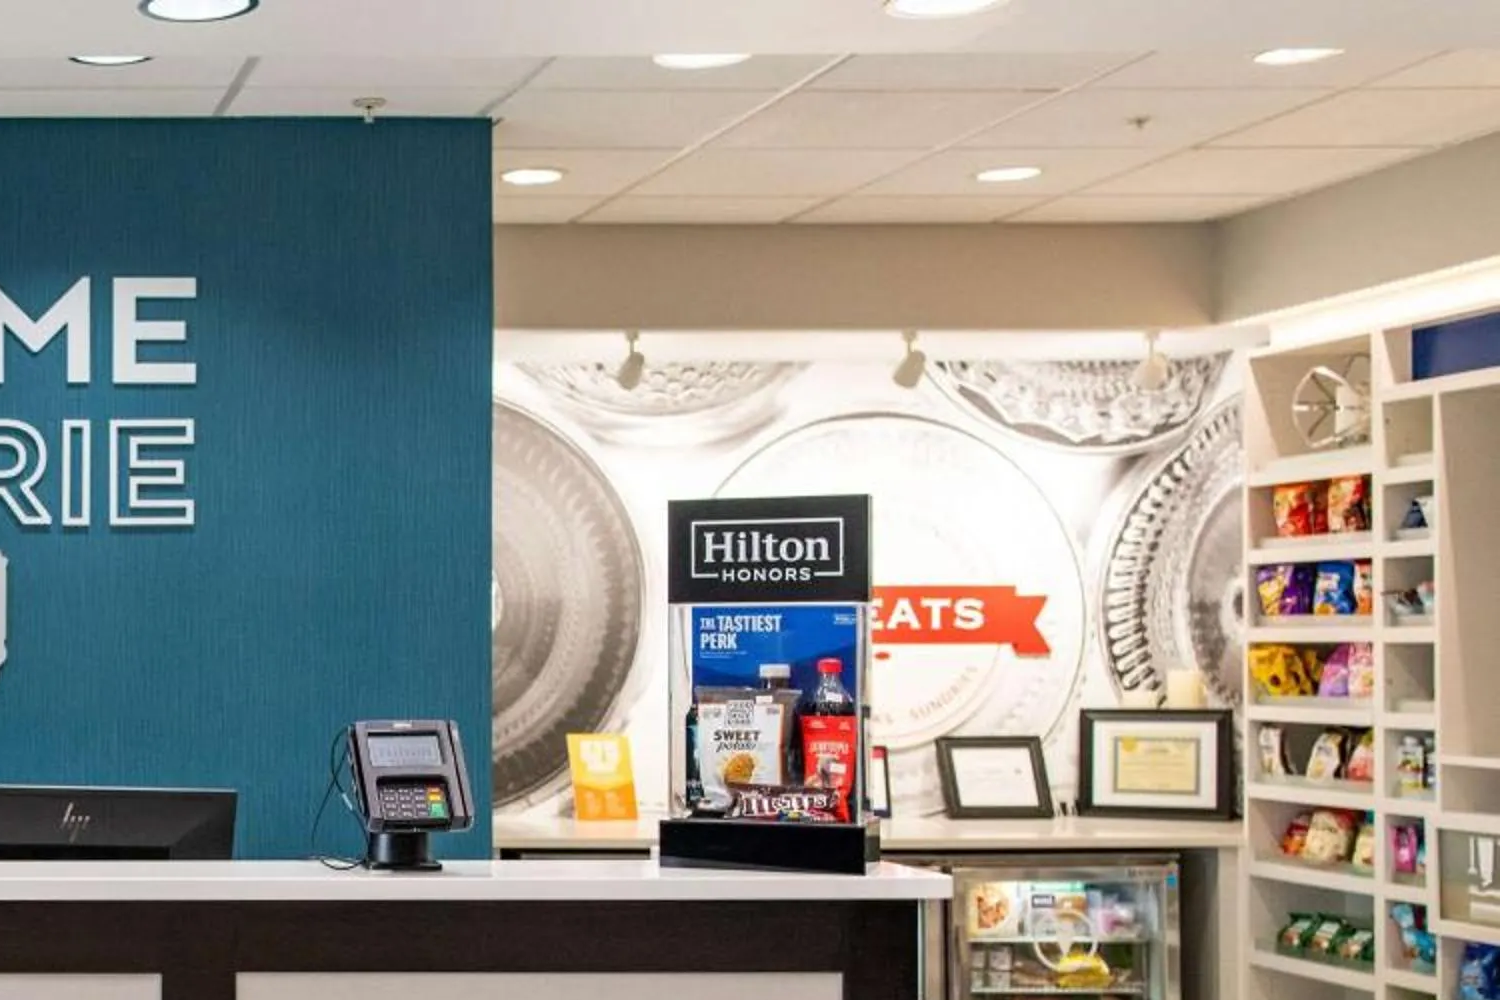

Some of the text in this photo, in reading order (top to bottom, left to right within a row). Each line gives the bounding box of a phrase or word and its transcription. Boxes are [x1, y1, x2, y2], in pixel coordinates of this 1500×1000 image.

[703, 531, 831, 563] Hilton
[722, 567, 812, 582] HONORS
[717, 615, 782, 633] TASTIEST
[700, 634, 737, 650] PERK
[713, 730, 762, 741] SWEET
